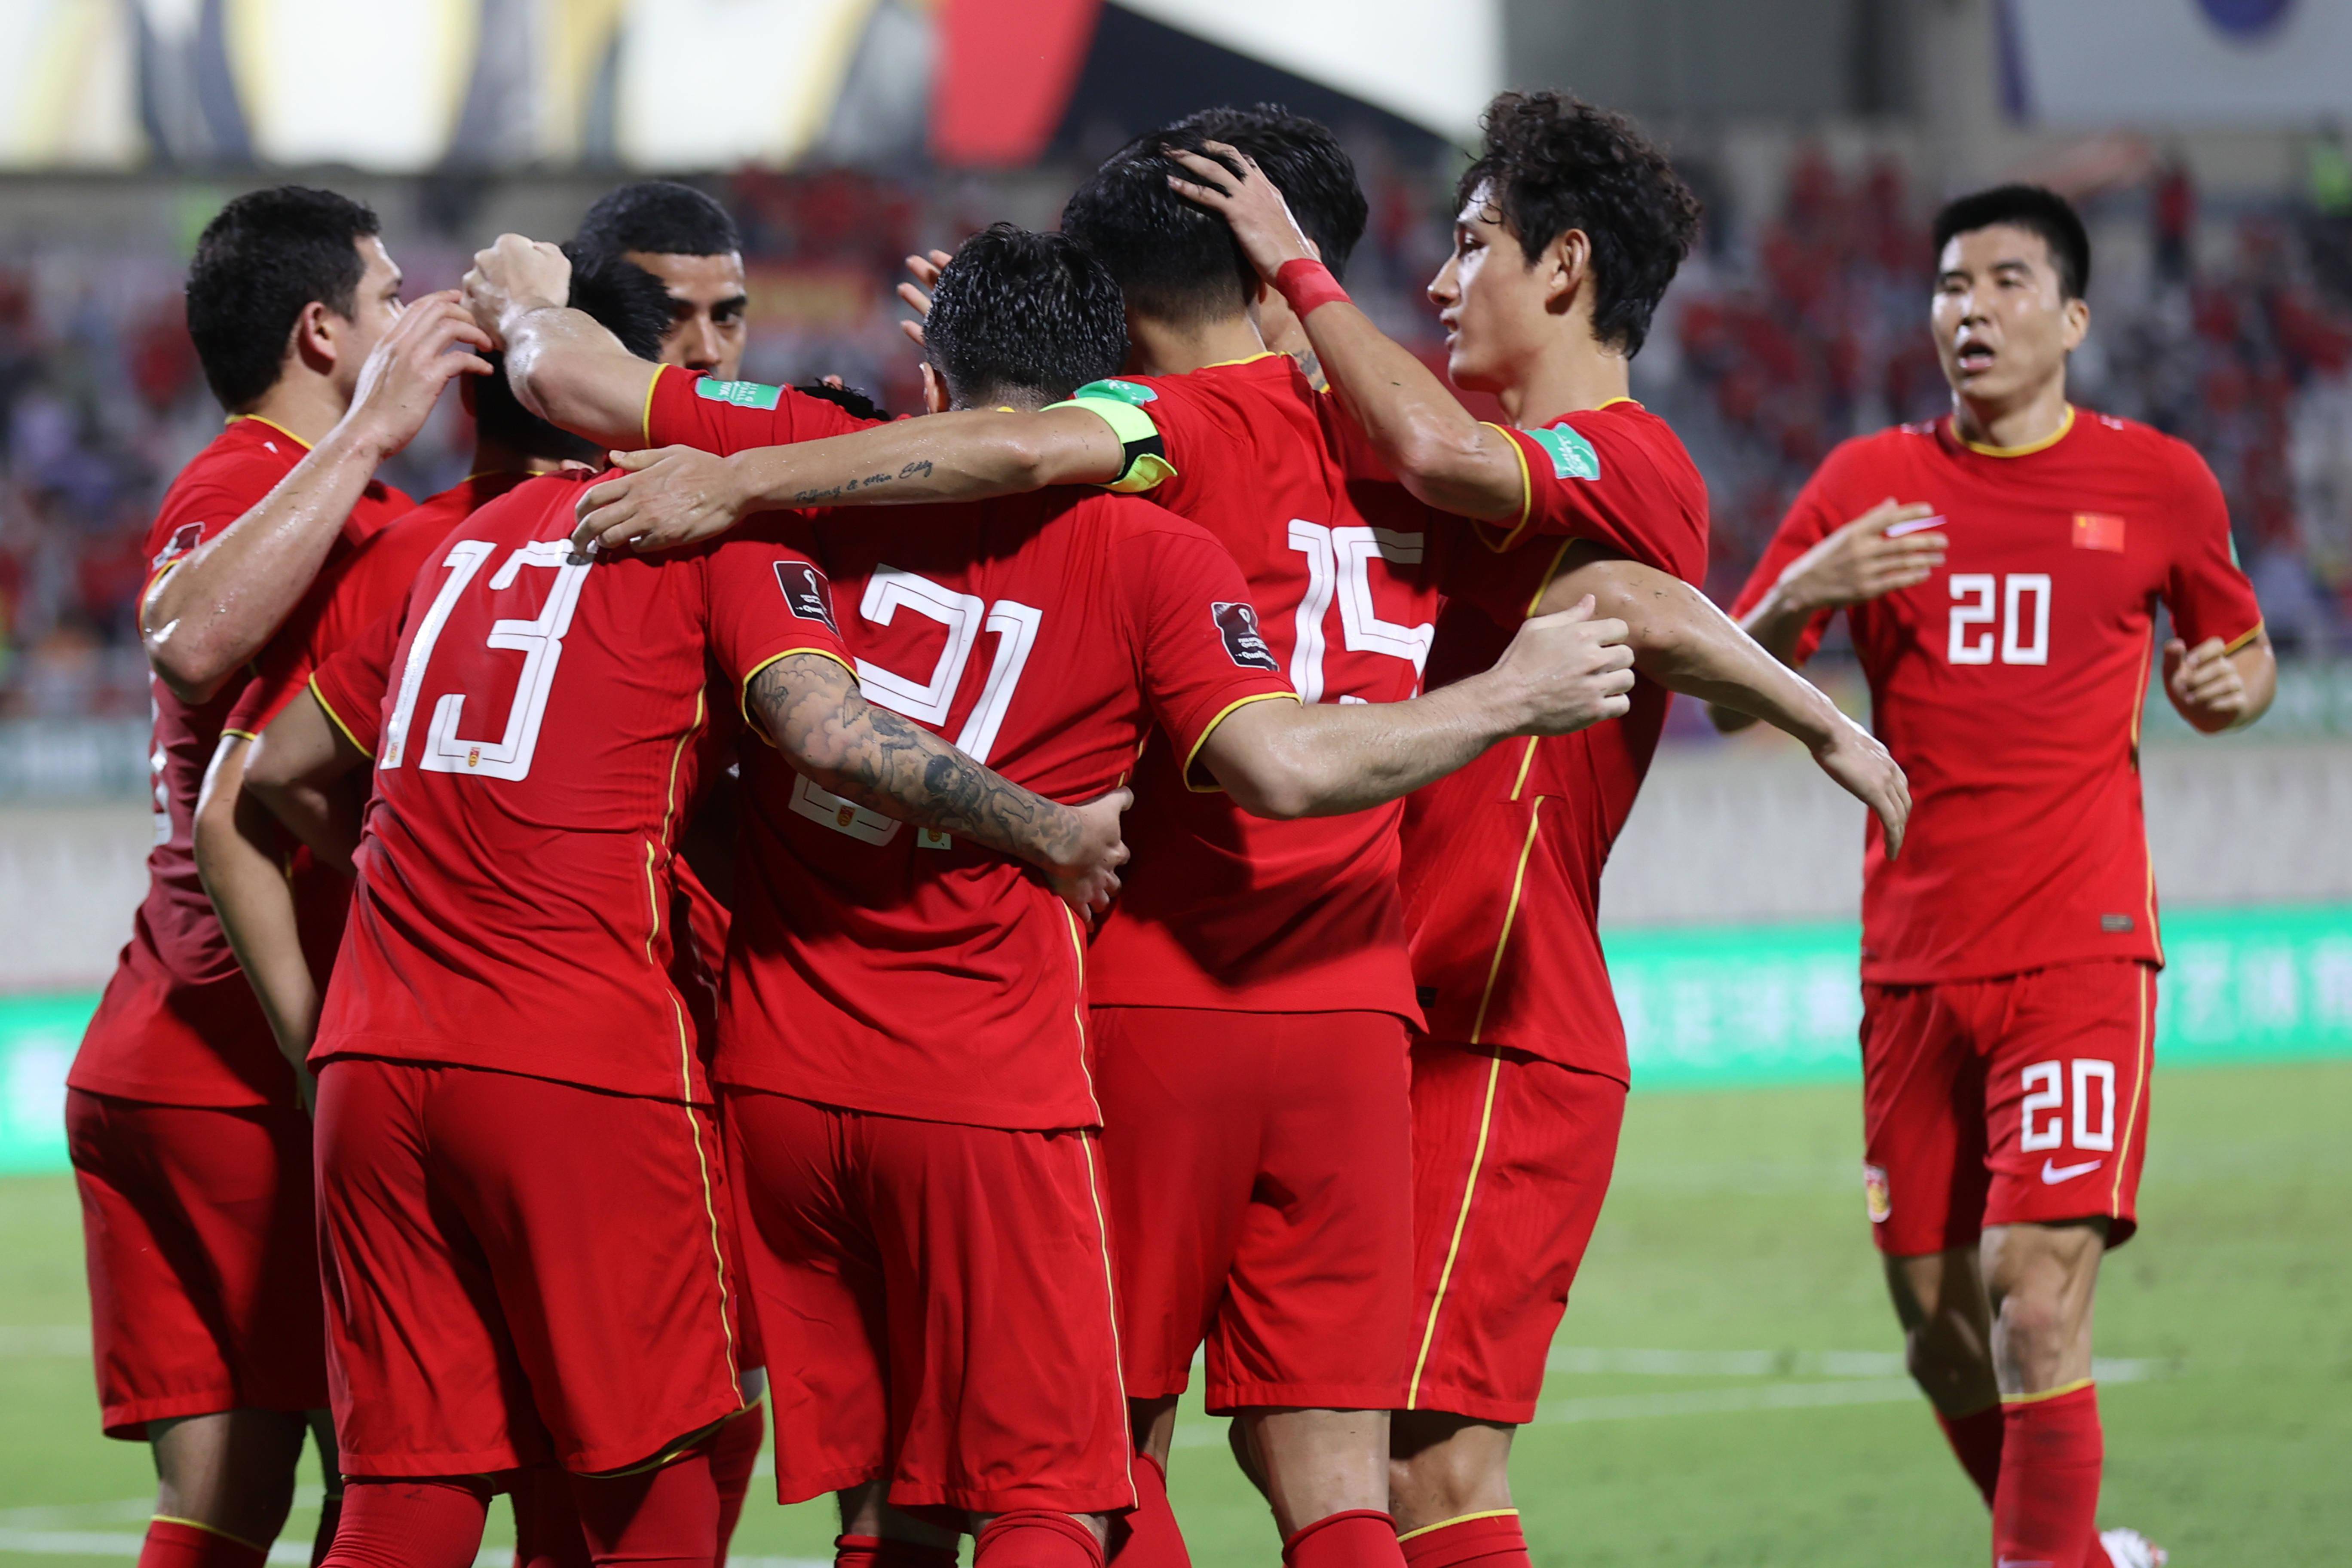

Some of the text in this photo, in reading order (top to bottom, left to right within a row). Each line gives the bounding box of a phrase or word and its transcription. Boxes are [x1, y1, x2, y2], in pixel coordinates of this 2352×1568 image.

[379, 539, 598, 781] 13
[1288, 519, 1435, 705] 15
[1948, 574, 2051, 665] 20
[788, 563, 1043, 850] 21
[2021, 1059, 2115, 1153] 20
